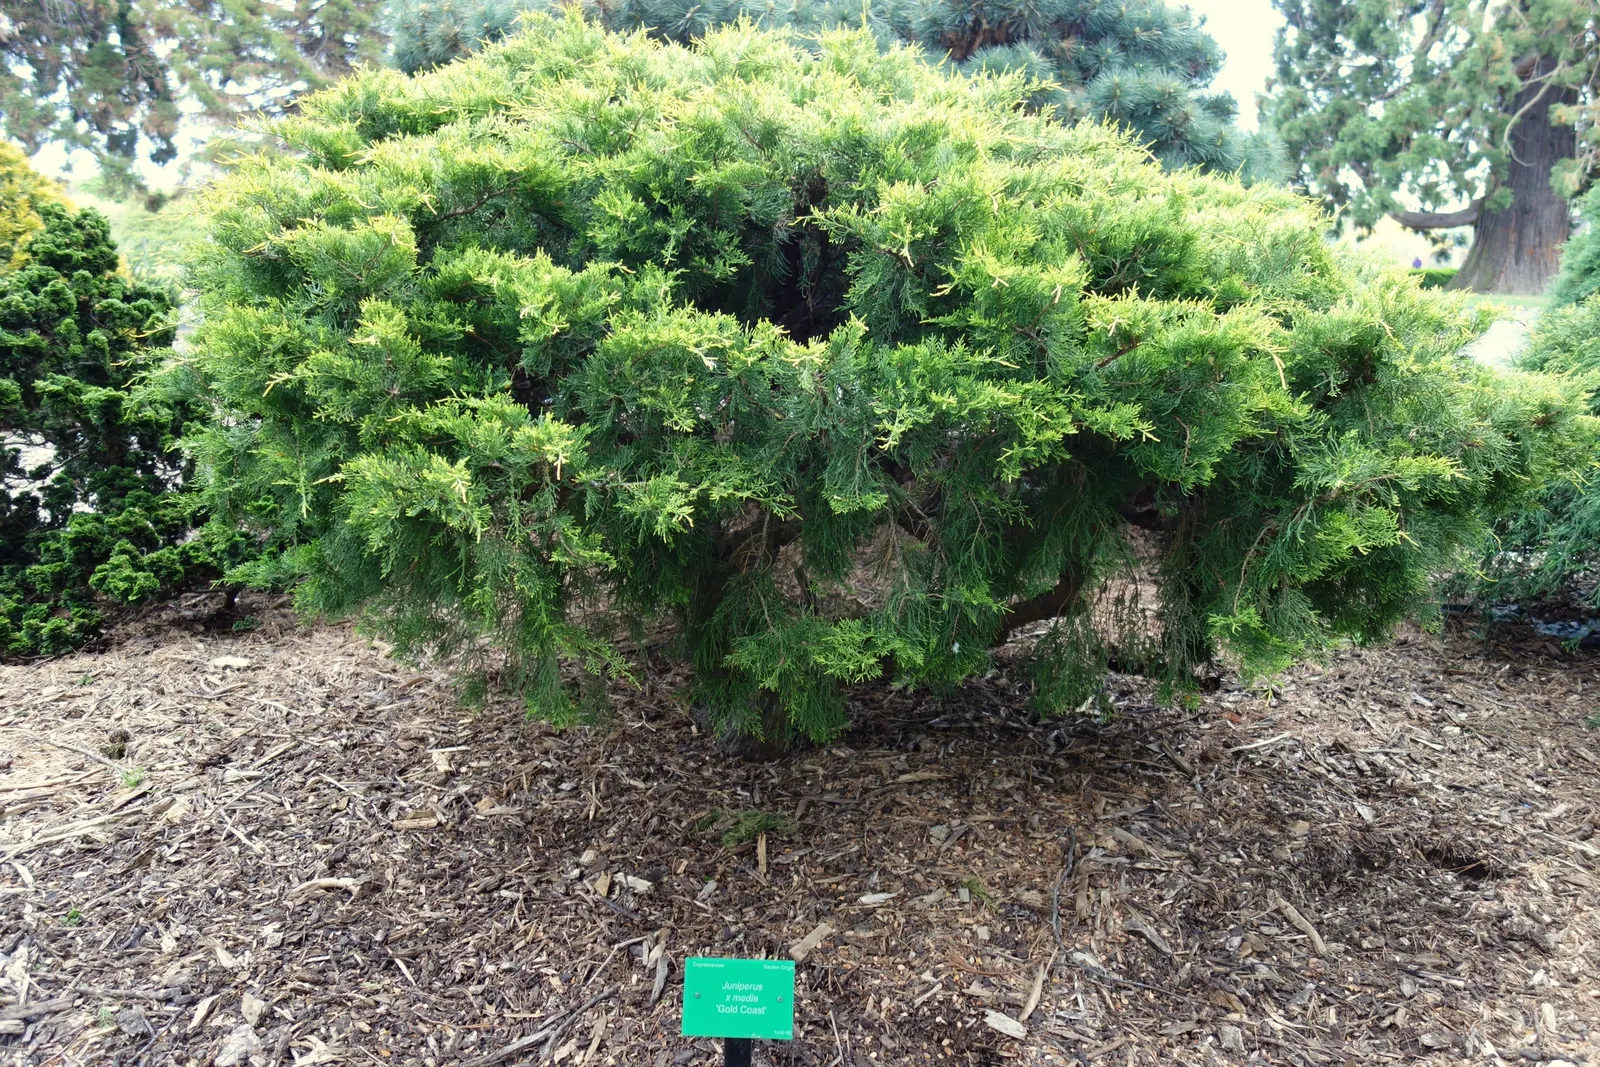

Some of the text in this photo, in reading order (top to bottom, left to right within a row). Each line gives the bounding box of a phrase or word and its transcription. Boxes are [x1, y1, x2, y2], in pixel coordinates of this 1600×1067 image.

[721, 981, 763, 992] Juniperus
[732, 994, 759, 1003] media
[716, 1004, 767, 1015] 'Gold Coast'
